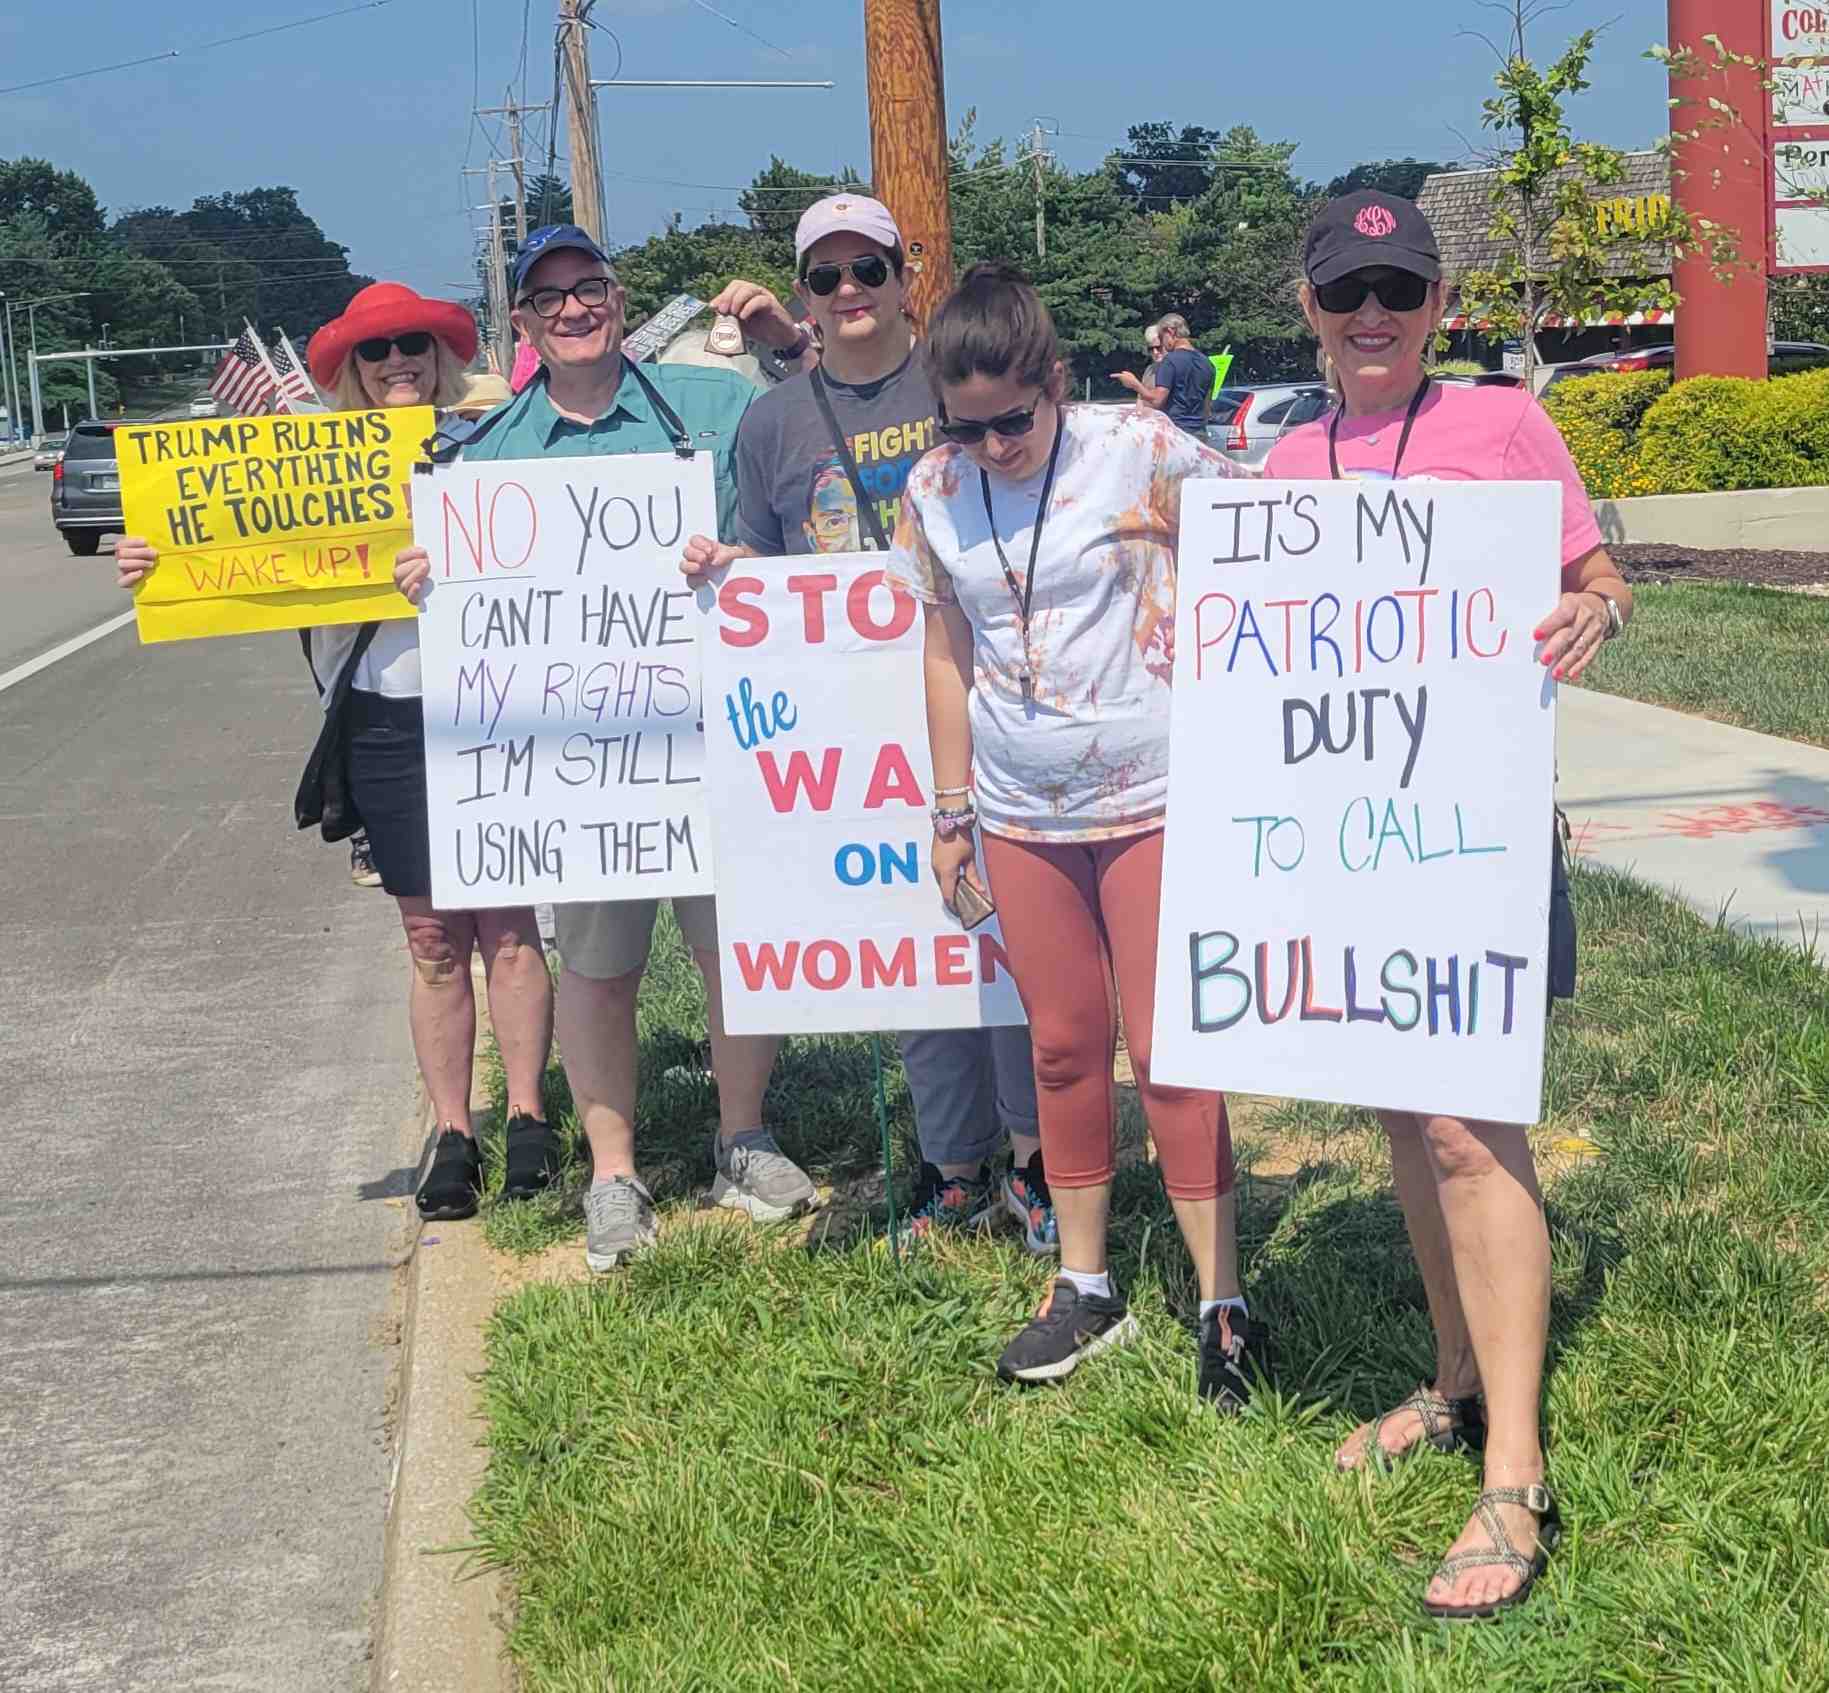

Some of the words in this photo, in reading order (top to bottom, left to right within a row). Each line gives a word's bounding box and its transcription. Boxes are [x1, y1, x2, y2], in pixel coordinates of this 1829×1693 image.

[128, 424, 259, 464] TRUMP
[273, 412, 392, 454] RUINS
[176, 450, 390, 501] EVERYTHING
[166, 504, 214, 545] HE
[442, 478, 536, 576] NO
[565, 484, 682, 574] YOU
[1212, 490, 1320, 564] IT'S
[1357, 490, 1434, 585] MY
[184, 551, 295, 591] WAKE
[303, 544, 369, 578] UP!
[461, 588, 563, 649] CAN'T
[581, 585, 694, 647] HAVE
[718, 570, 916, 648] STO
[1194, 588, 1508, 679] PATRIOTIC
[455, 659, 517, 738] MY
[726, 677, 797, 750] the
[456, 735, 535, 804] I'M
[555, 732, 700, 788] STILL
[1283, 686, 1427, 788] DUTY
[756, 744, 926, 813] WA
[456, 819, 566, 885] USING
[581, 815, 698, 875] THEM
[834, 842, 919, 886] ON
[1232, 816, 1305, 876] TO
[1339, 797, 1506, 873] CALL
[1190, 931, 1528, 1036] BULLSHIT
